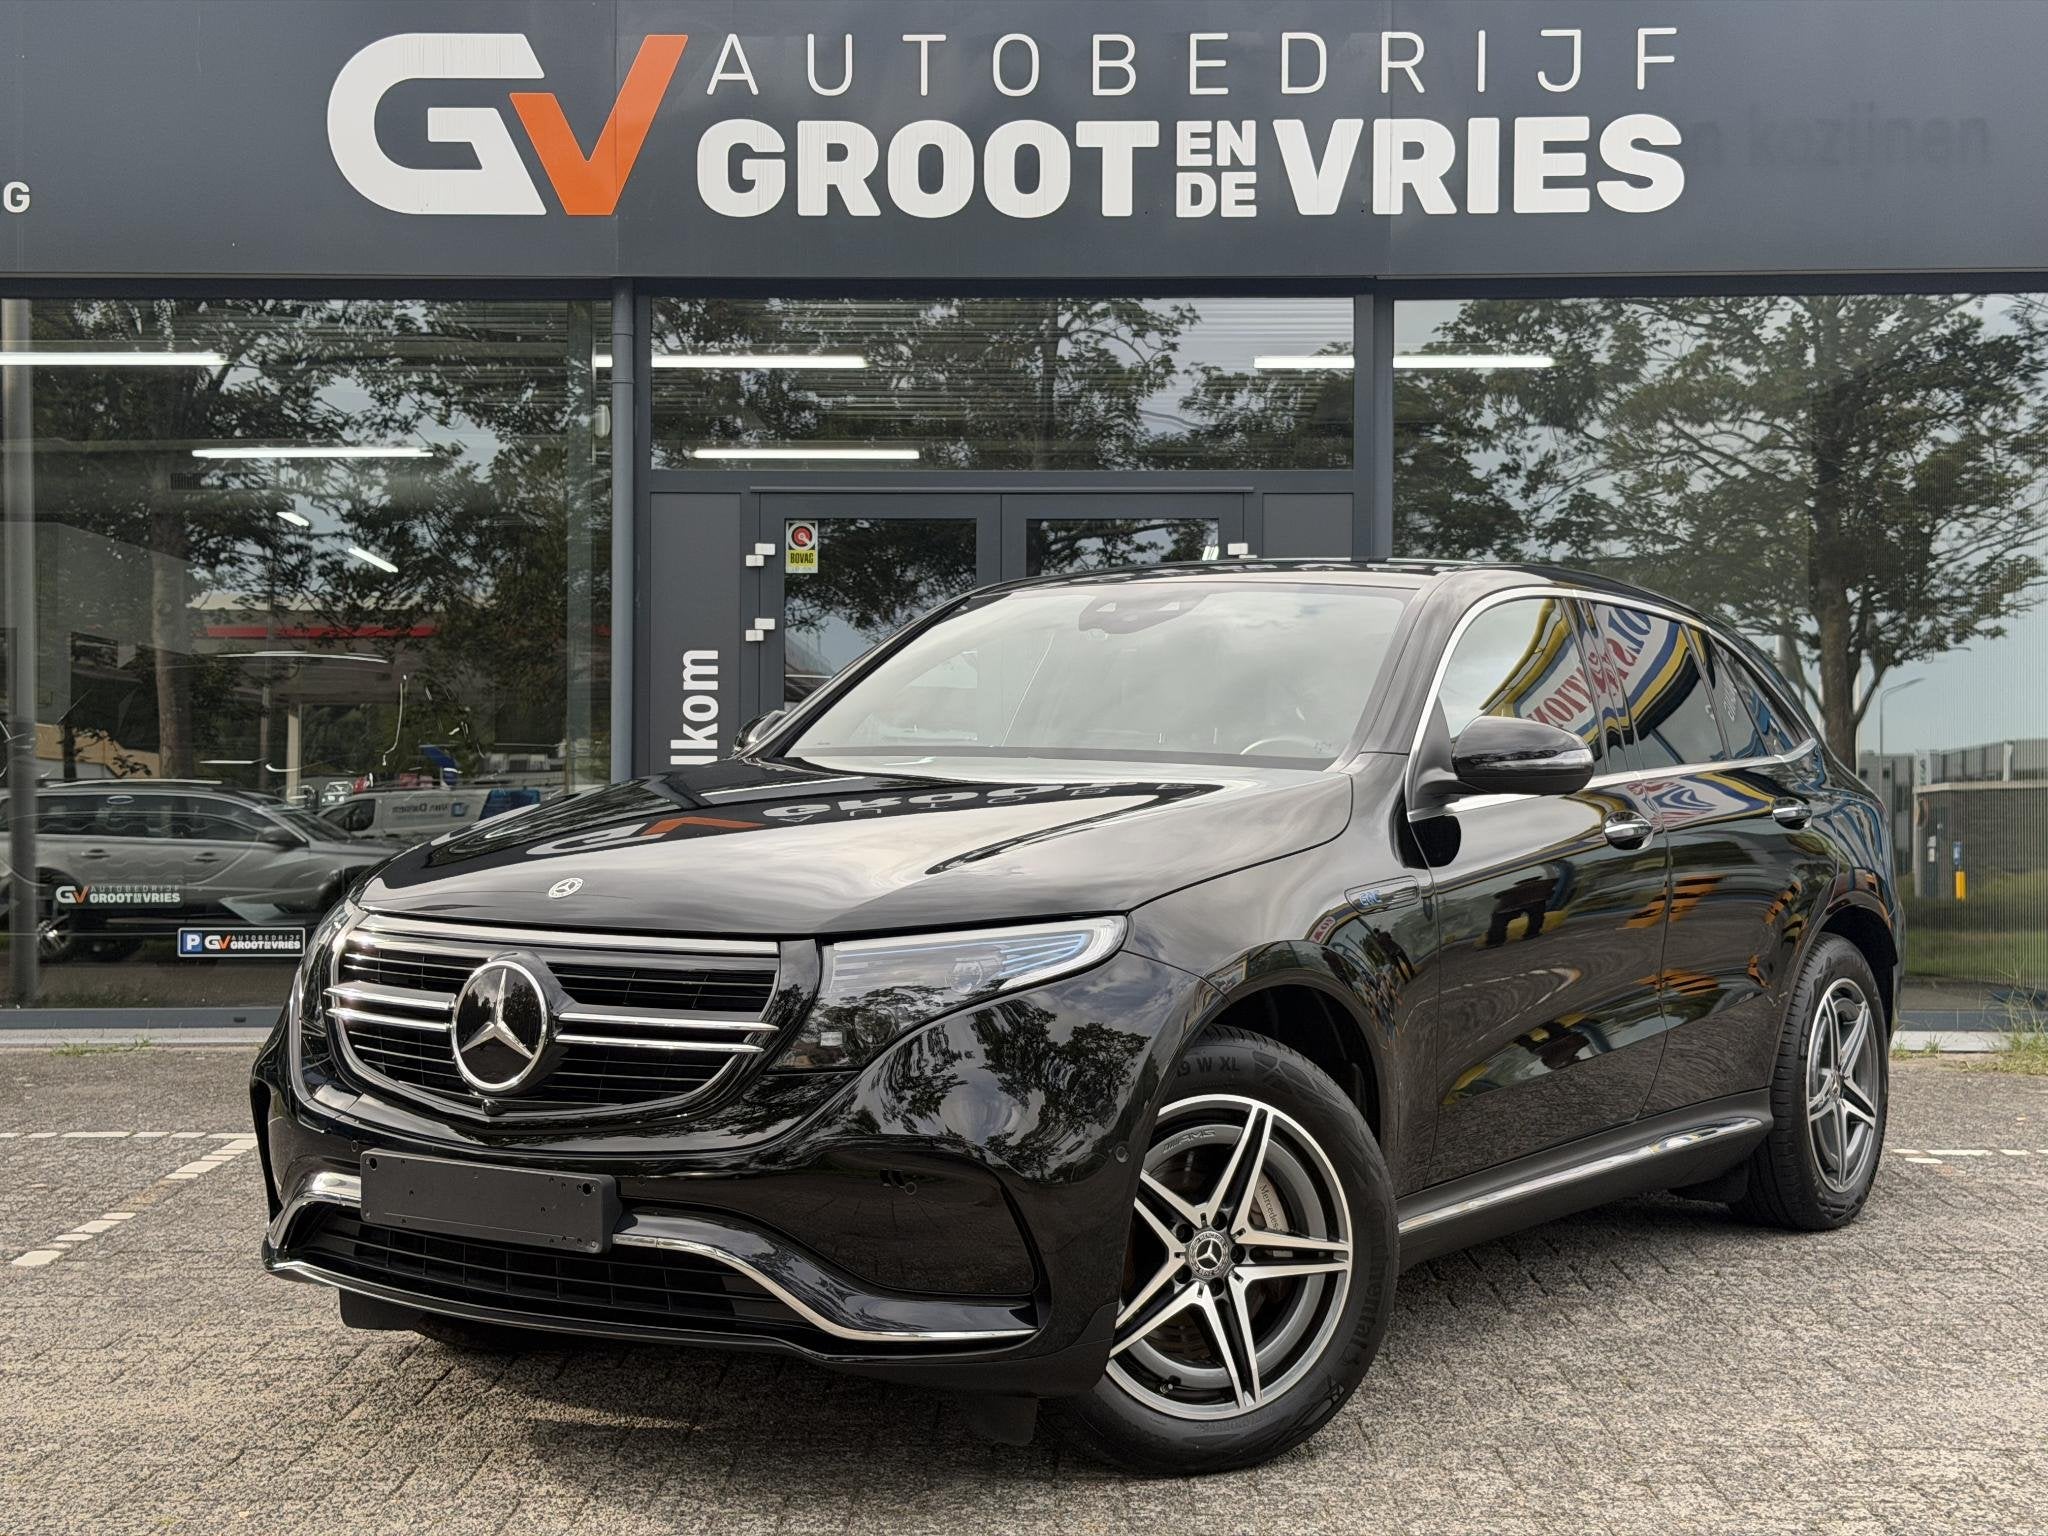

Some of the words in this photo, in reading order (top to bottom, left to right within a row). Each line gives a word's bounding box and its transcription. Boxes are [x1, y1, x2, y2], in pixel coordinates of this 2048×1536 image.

[705, 26, 1678, 97] AUTOBEDRIJF
[327, 32, 689, 216] GV
[696, 118, 1160, 218] GROOT
[1176, 120, 1257, 167] EN
[1176, 171, 1257, 218] DE
[1272, 113, 1686, 215] VRIES
[790, 552, 814, 564] BOVAG
[670, 650, 719, 766] lkom
[89, 893, 134, 904] GROOT
[143, 892, 181, 903] VRIES
[186, 934, 201, 951] P
